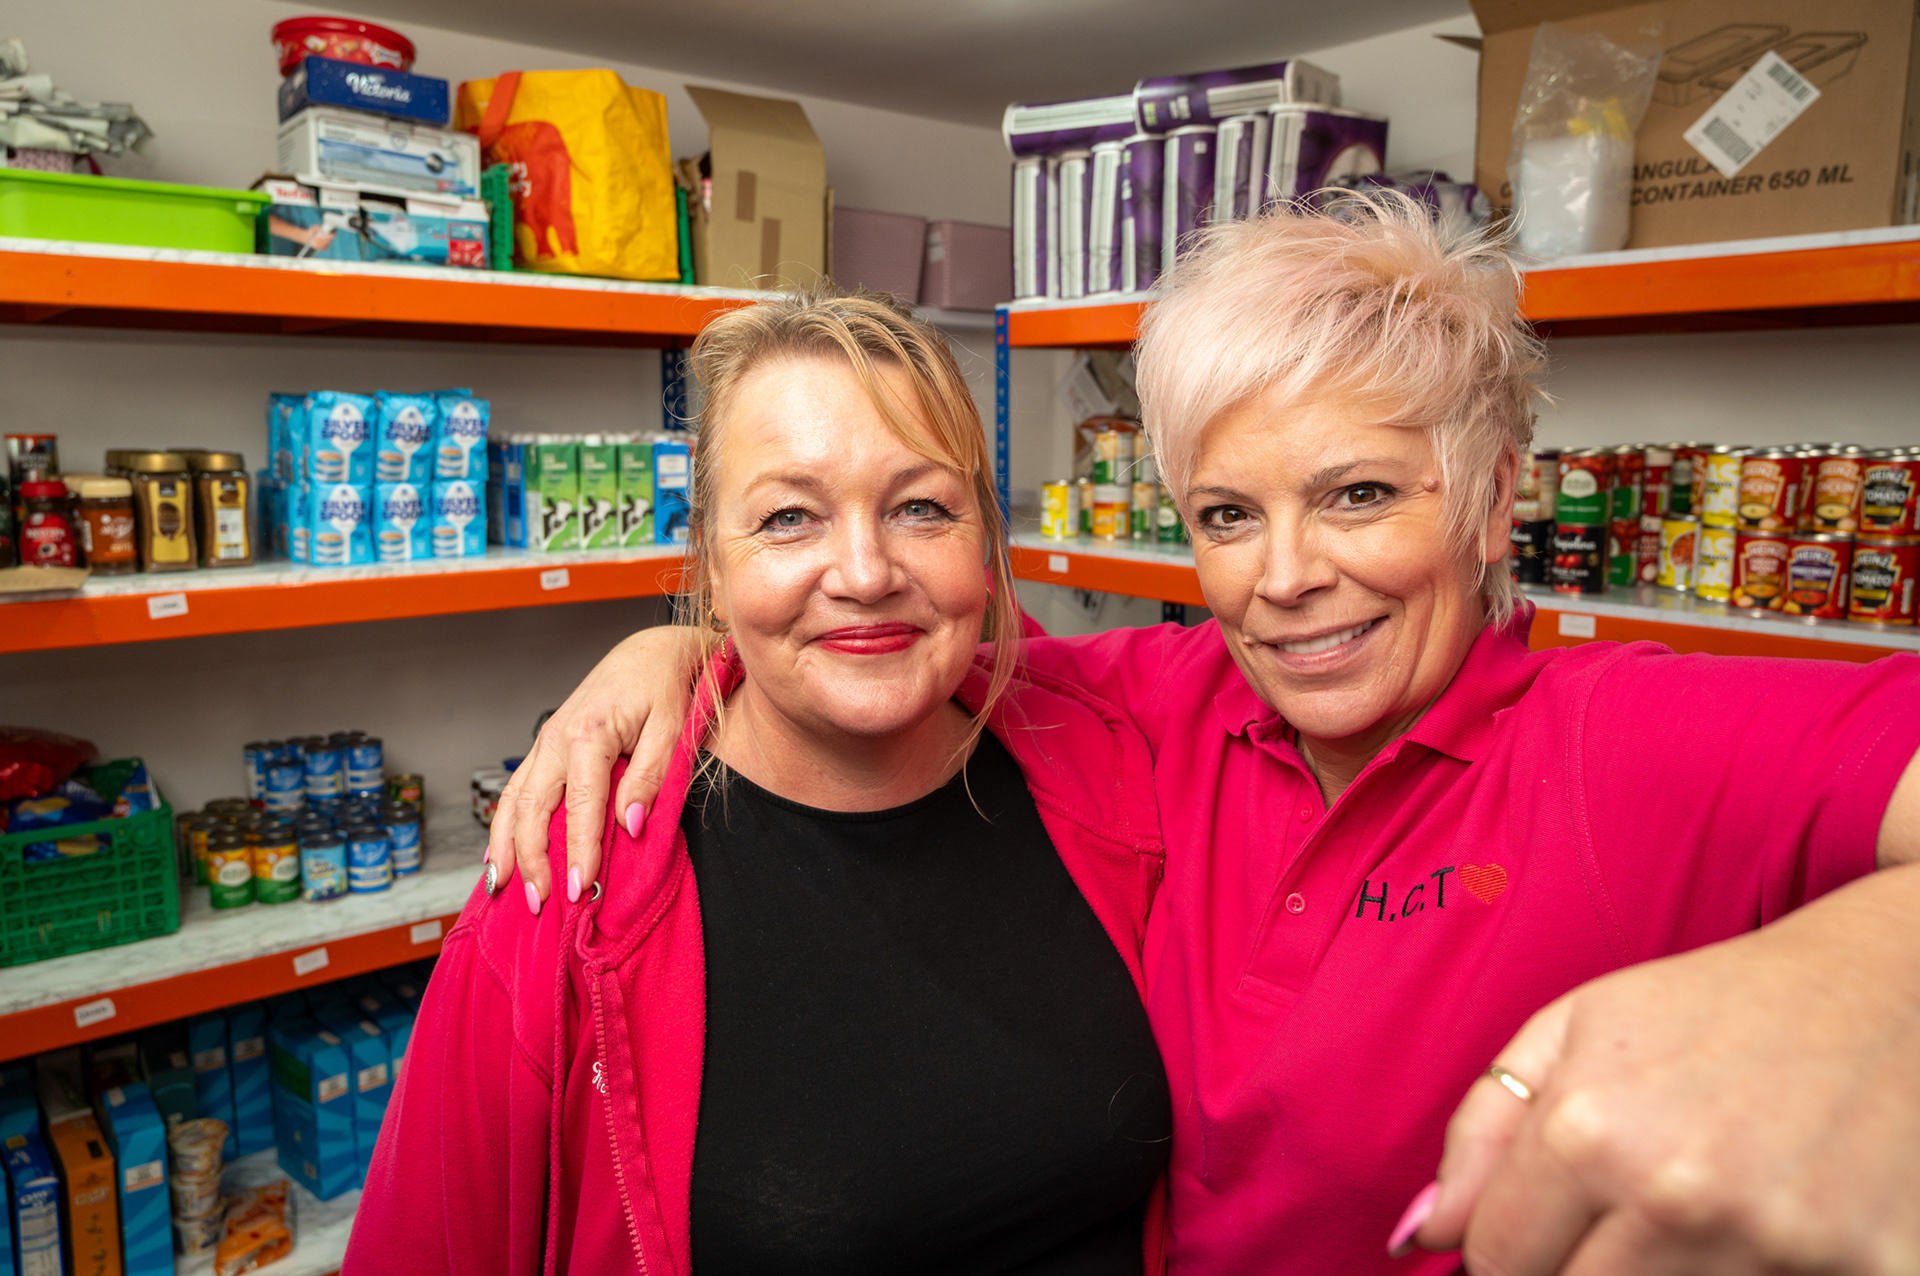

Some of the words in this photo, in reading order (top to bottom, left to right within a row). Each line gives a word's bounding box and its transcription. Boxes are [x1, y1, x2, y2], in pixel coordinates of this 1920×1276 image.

[346, 72, 412, 103] Victoria
[1632, 156, 1718, 182] ANGULA
[1631, 174, 1764, 205] CONTAINER
[1768, 168, 1811, 191] 650
[1816, 163, 1855, 186] ML
[1868, 470, 1906, 483] HEINZ
[1864, 490, 1906, 503] TOMATO
[1796, 551, 1831, 562] HEINZ
[1854, 572, 1893, 586] TOMATO
[1355, 866, 1456, 922] H.C.T
